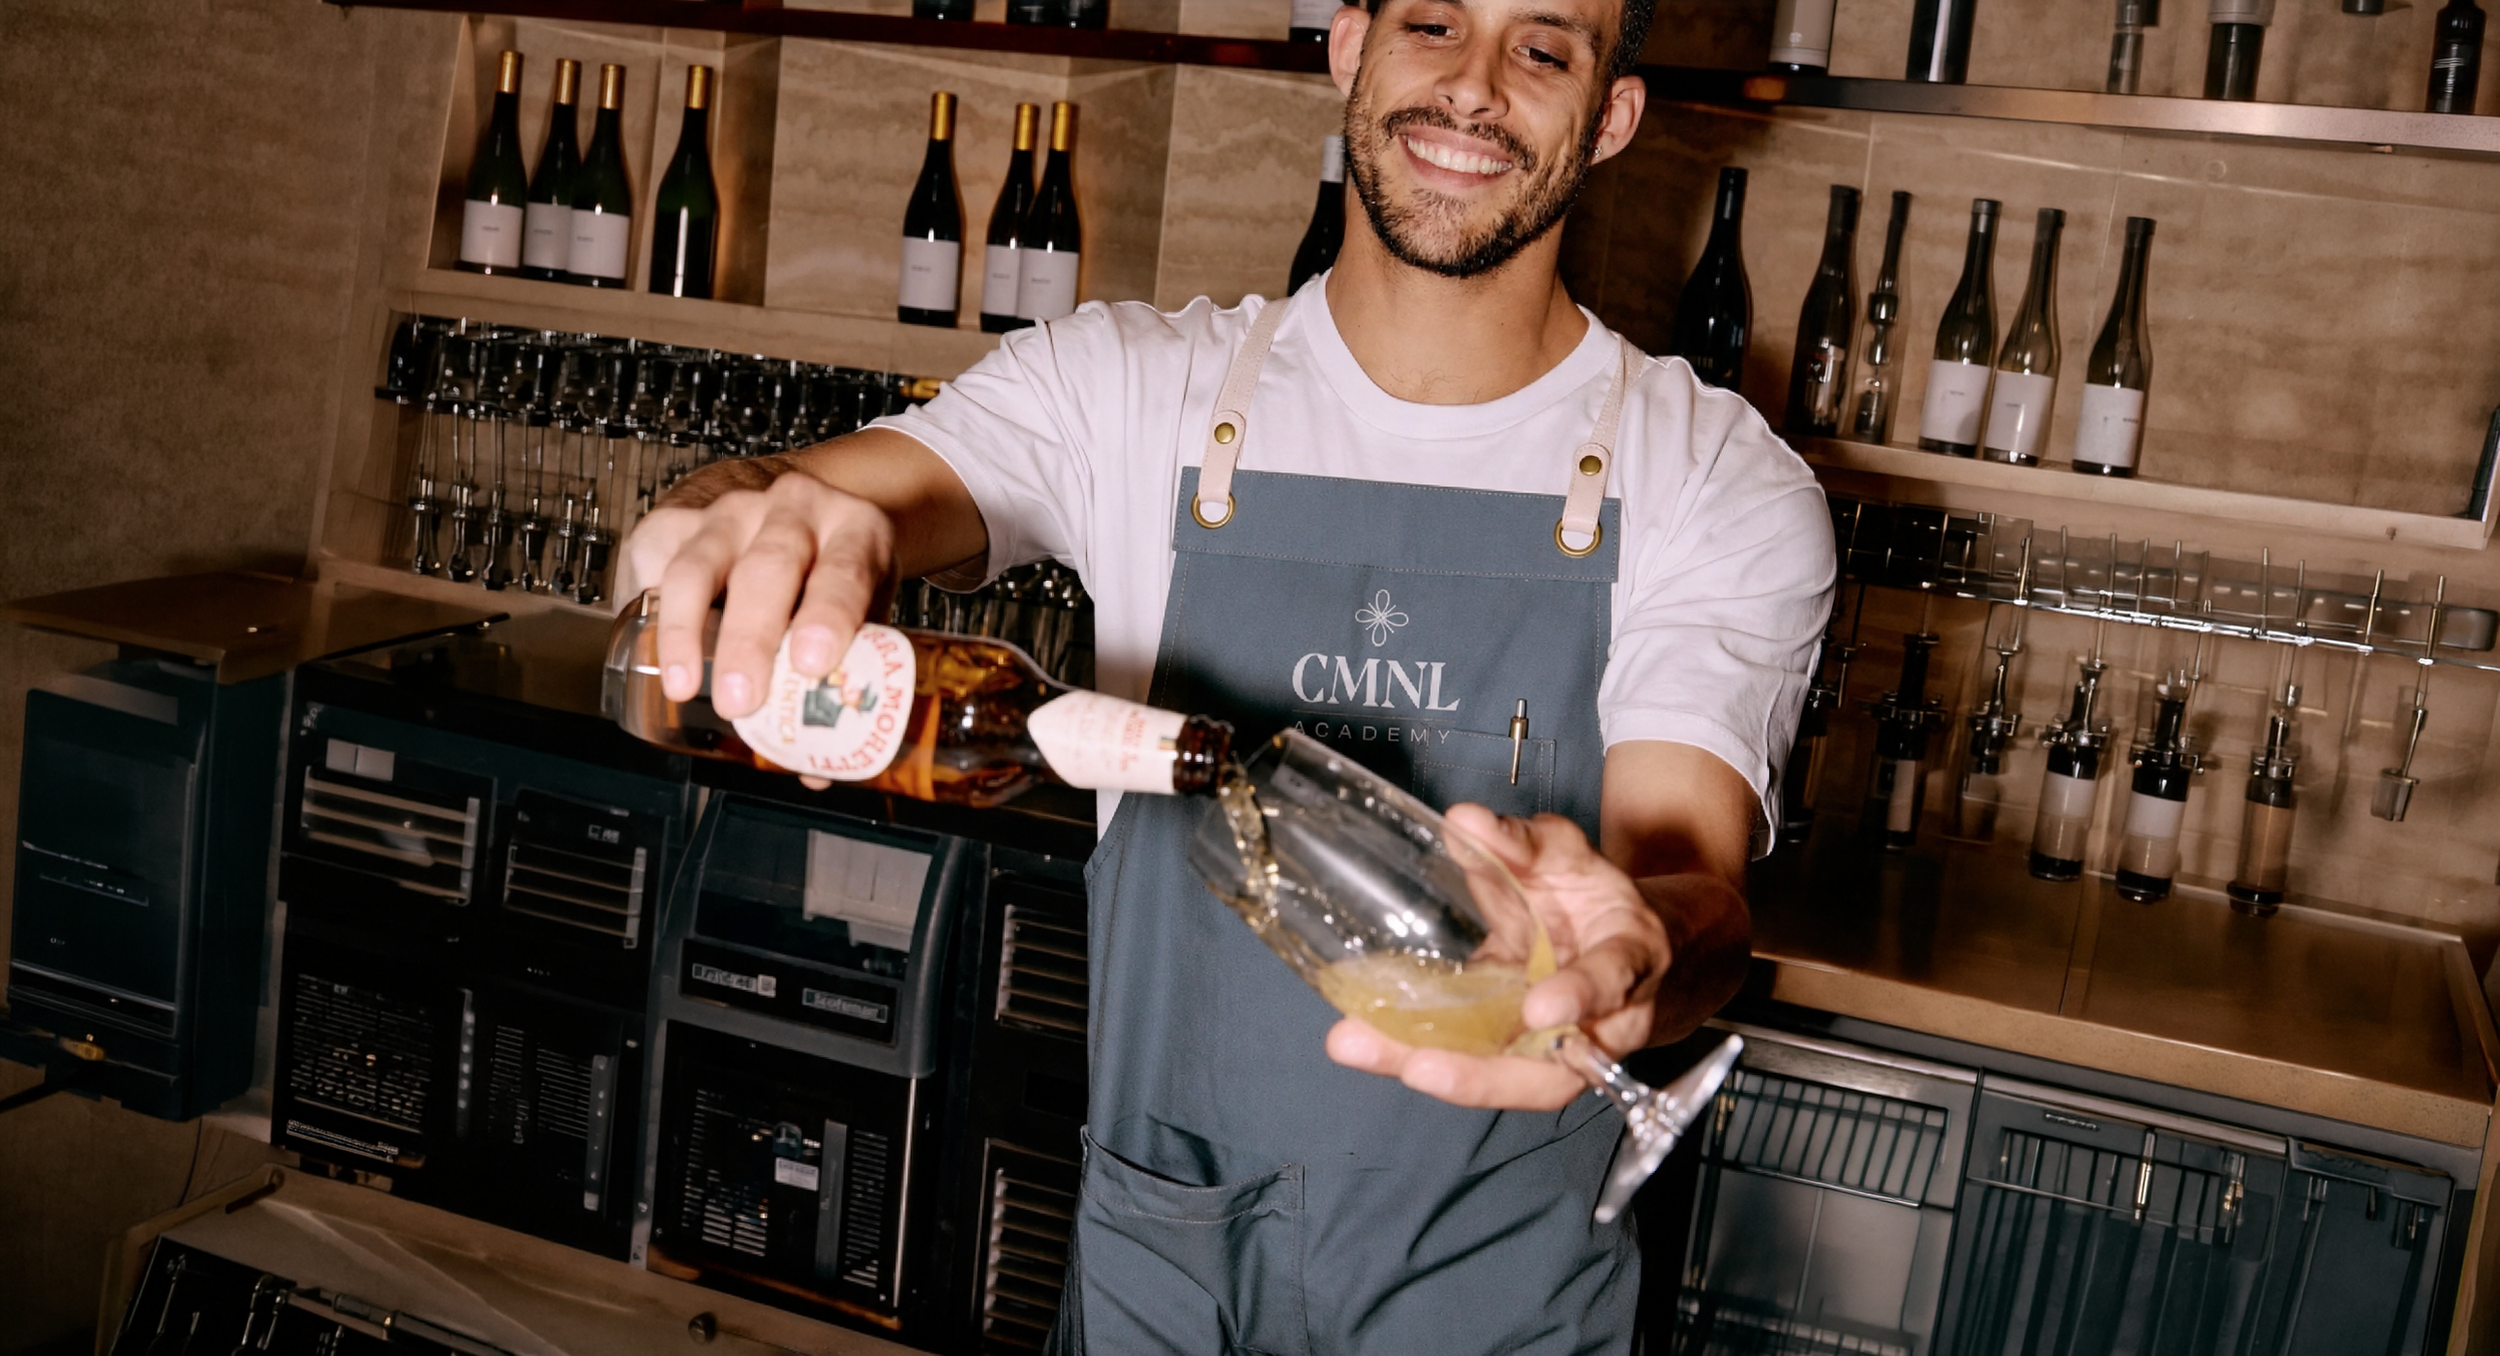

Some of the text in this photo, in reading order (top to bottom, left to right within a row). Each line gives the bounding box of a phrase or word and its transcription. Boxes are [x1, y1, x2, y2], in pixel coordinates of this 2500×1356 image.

[807, 628, 905, 773] RRA MORETTI
[1292, 653, 1460, 711] CMNL
[1295, 720, 1450, 744] ACADEMY
